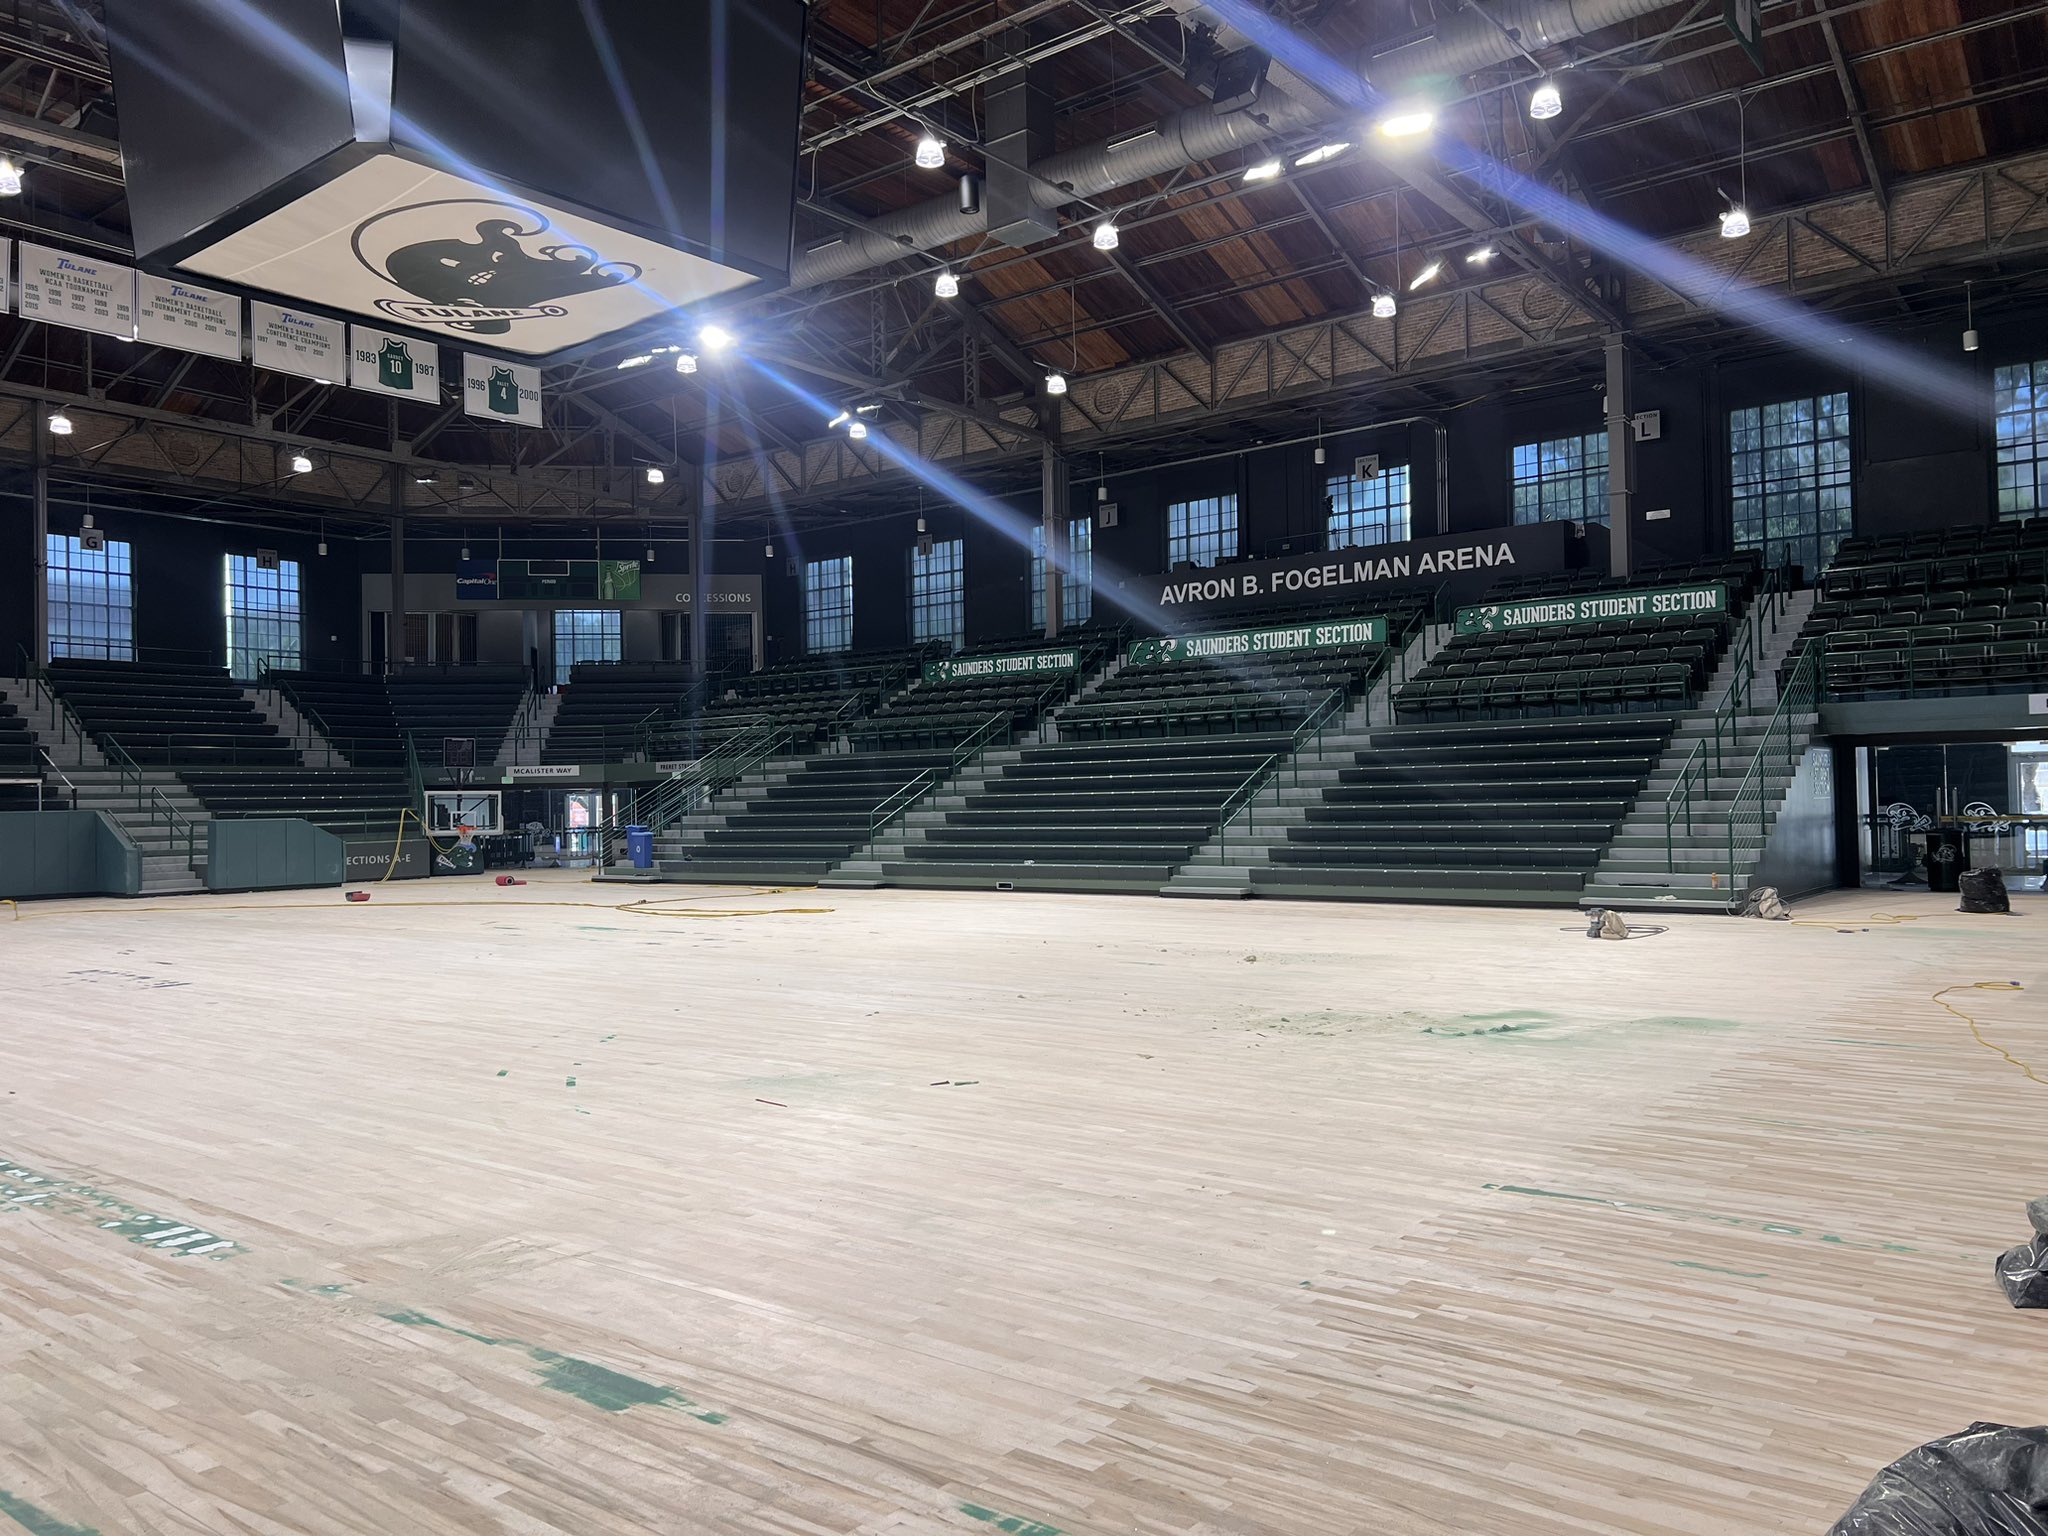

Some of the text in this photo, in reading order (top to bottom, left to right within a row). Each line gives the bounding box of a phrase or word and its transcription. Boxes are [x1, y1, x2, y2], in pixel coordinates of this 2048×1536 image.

[57, 258, 97, 275] TULANE
[40, 268, 113, 291] WOMEN'S BASKETBALL
[45, 278, 108, 298] NCAA TOURNAMENT
[171, 285, 208, 302] TULANE
[151, 301, 226, 326] TOURNAMENT CHAMPIONS
[155, 295, 222, 318] WOMEN'S BASKETBALL
[404, 307, 524, 317] TULANE
[282, 312, 315, 328] TULANE
[296, 329, 328, 342] BASKETBALL
[356, 350, 376, 364] 1983
[390, 360, 402, 374] 10
[416, 363, 434, 376] 1987
[468, 378, 486, 391] 1996
[500, 387, 507, 400] 4
[520, 389, 538, 401] 2000
[1642, 422, 1651, 437] L
[1362, 464, 1373, 478] K
[86, 537, 97, 548] G
[263, 556, 272, 566] H
[1160, 542, 1516, 605] AVRON B. FOGELMAN ARENA
[675, 593, 751, 603] COESSIONS
[1503, 590, 1716, 625] SAUNDERS STUDENT SECTION
[1186, 622, 1373, 658] SAUNDERS STUDENT SECTION
[952, 653, 1074, 677] SAUNDERS STUDENT SECTION
[346, 855, 390, 865] ECTIONS
